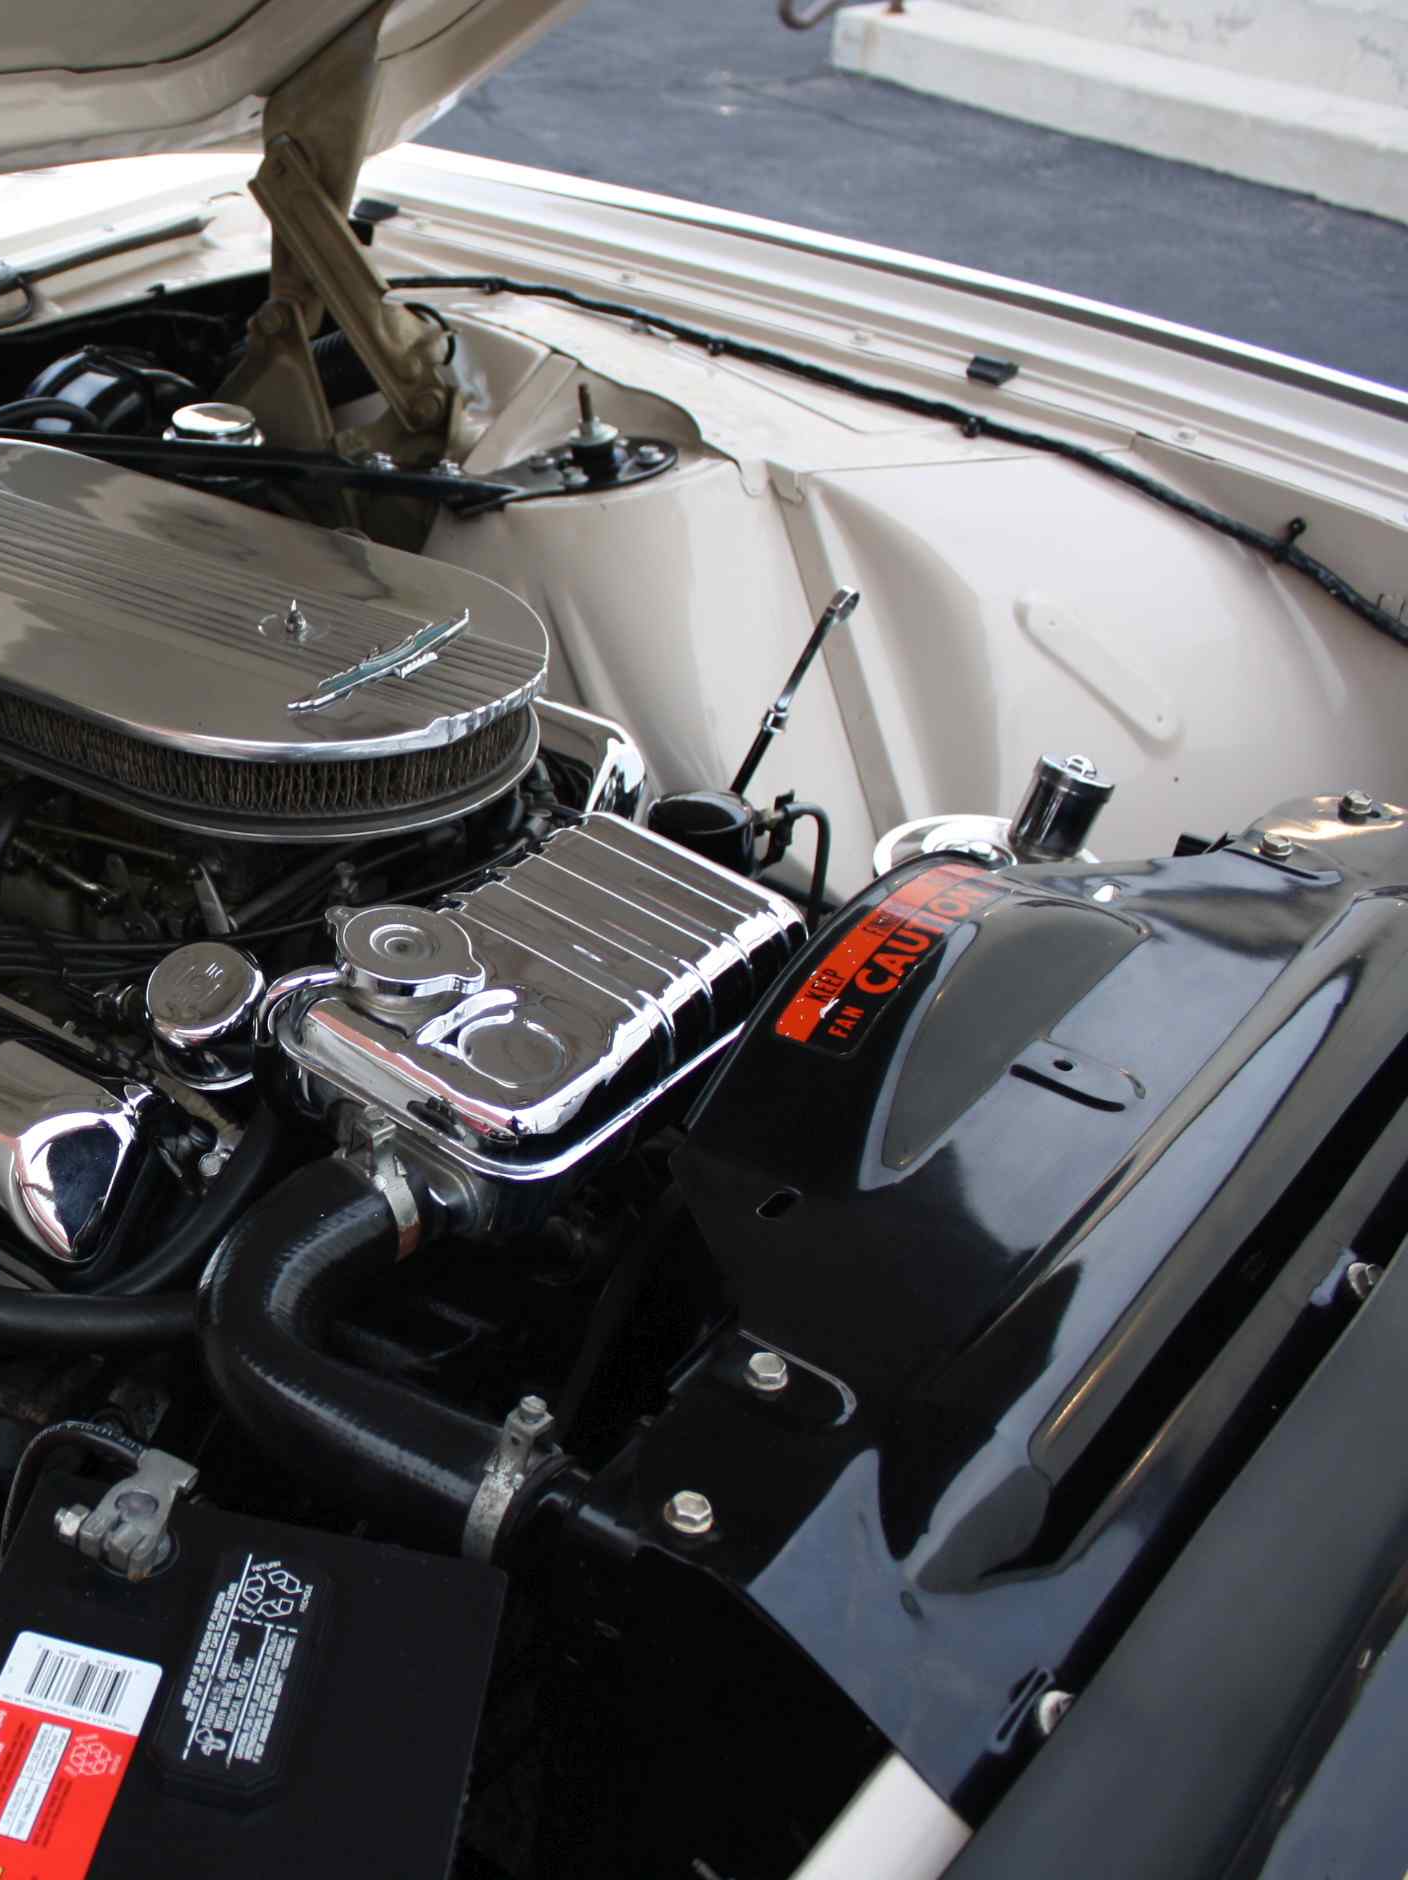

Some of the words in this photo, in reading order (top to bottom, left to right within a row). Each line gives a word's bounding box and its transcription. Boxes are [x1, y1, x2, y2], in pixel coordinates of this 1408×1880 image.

[807, 968, 847, 1003] KEEP
[828, 1005, 864, 1039] FAN
[854, 883, 988, 995] CAUTION
